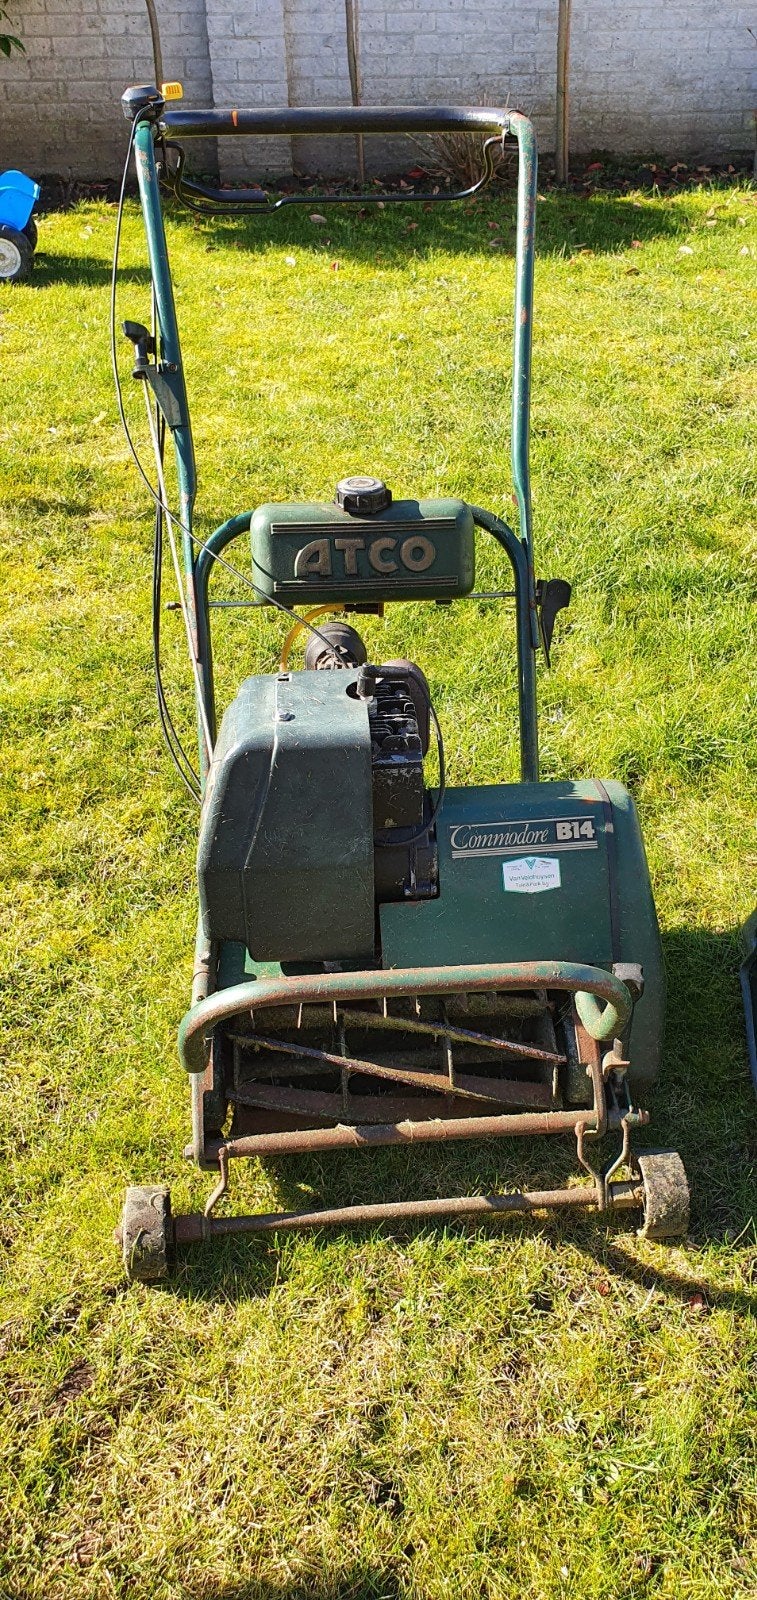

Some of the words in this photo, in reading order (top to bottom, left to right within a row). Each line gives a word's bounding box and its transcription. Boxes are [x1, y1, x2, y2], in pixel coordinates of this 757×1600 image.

[294, 536, 436, 577] ATCO
[450, 823, 549, 850] Commodore
[556, 820, 595, 841] B14
